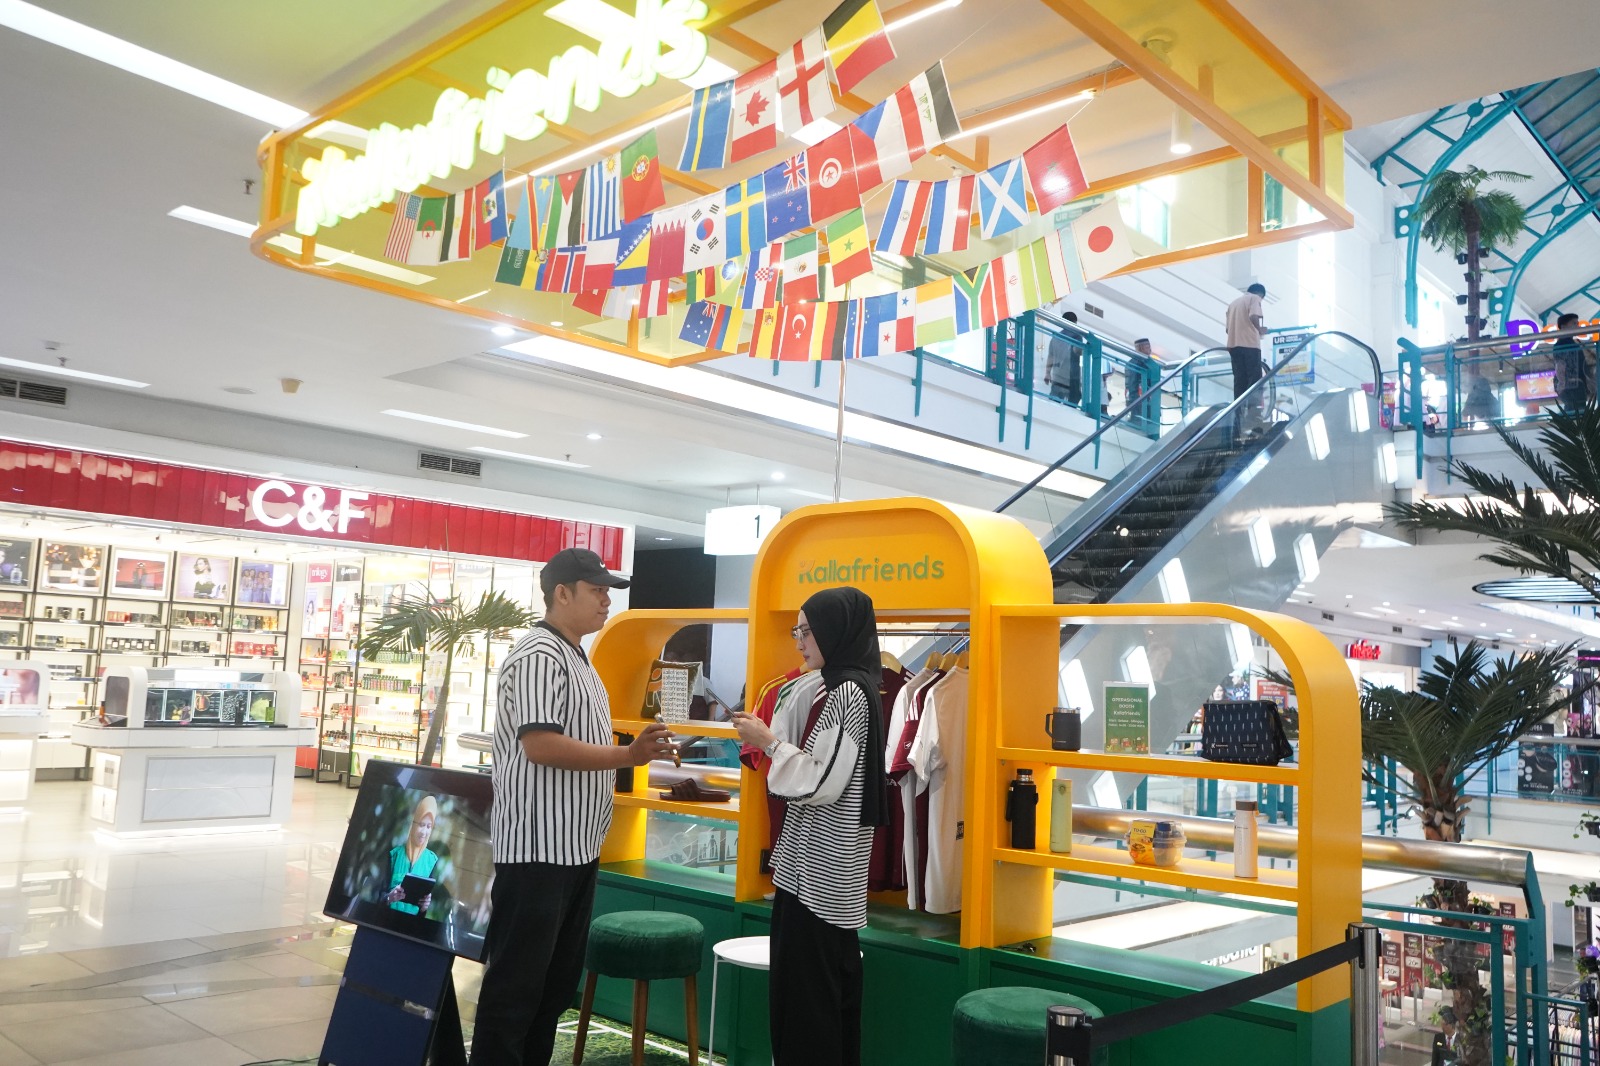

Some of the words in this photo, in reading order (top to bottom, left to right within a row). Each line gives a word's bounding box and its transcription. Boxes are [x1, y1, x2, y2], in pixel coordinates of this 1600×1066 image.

[252, 480, 369, 534] C&F
[754, 514, 761, 539] 1
[799, 555, 945, 584] Kallafriends
